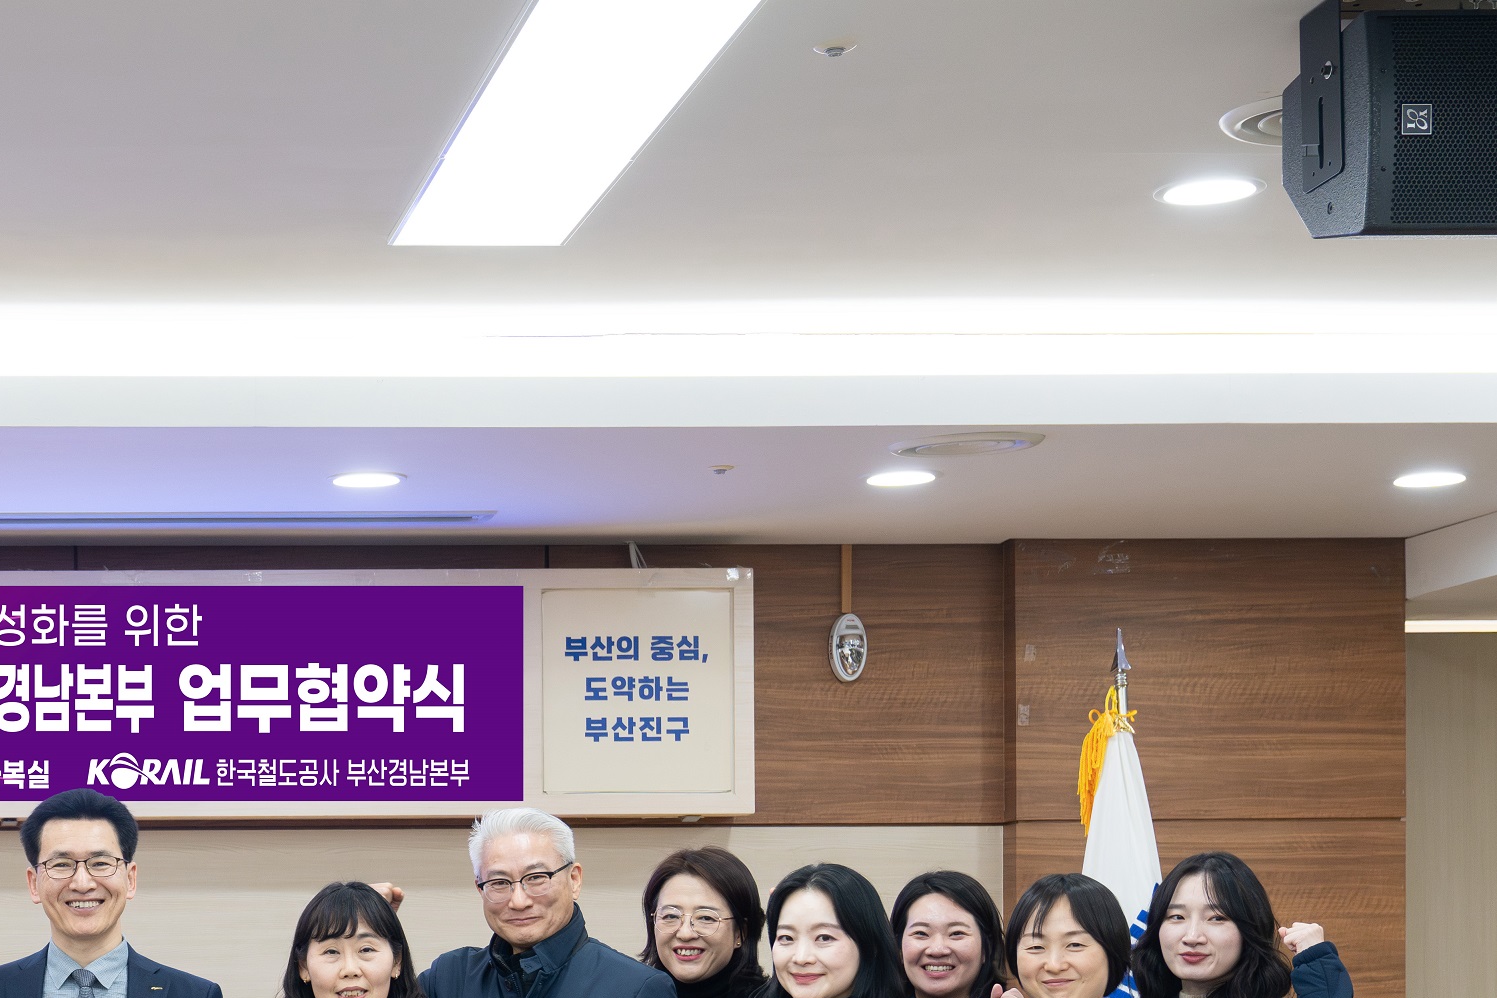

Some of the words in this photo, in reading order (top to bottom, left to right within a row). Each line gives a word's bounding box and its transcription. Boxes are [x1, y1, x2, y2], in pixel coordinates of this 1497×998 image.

[124, 603, 203, 647] 위한
[564, 636, 640, 662] 부산의
[650, 635, 709, 664] 중심,
[178, 662, 465, 734] 업무협약식
[584, 676, 690, 702] 도약하는
[584, 717, 690, 743] 부산진구
[87, 753, 210, 790] KORAIL
[216, 759, 340, 787] 한국철도공사
[346, 759, 470, 787] 부산경남본부
